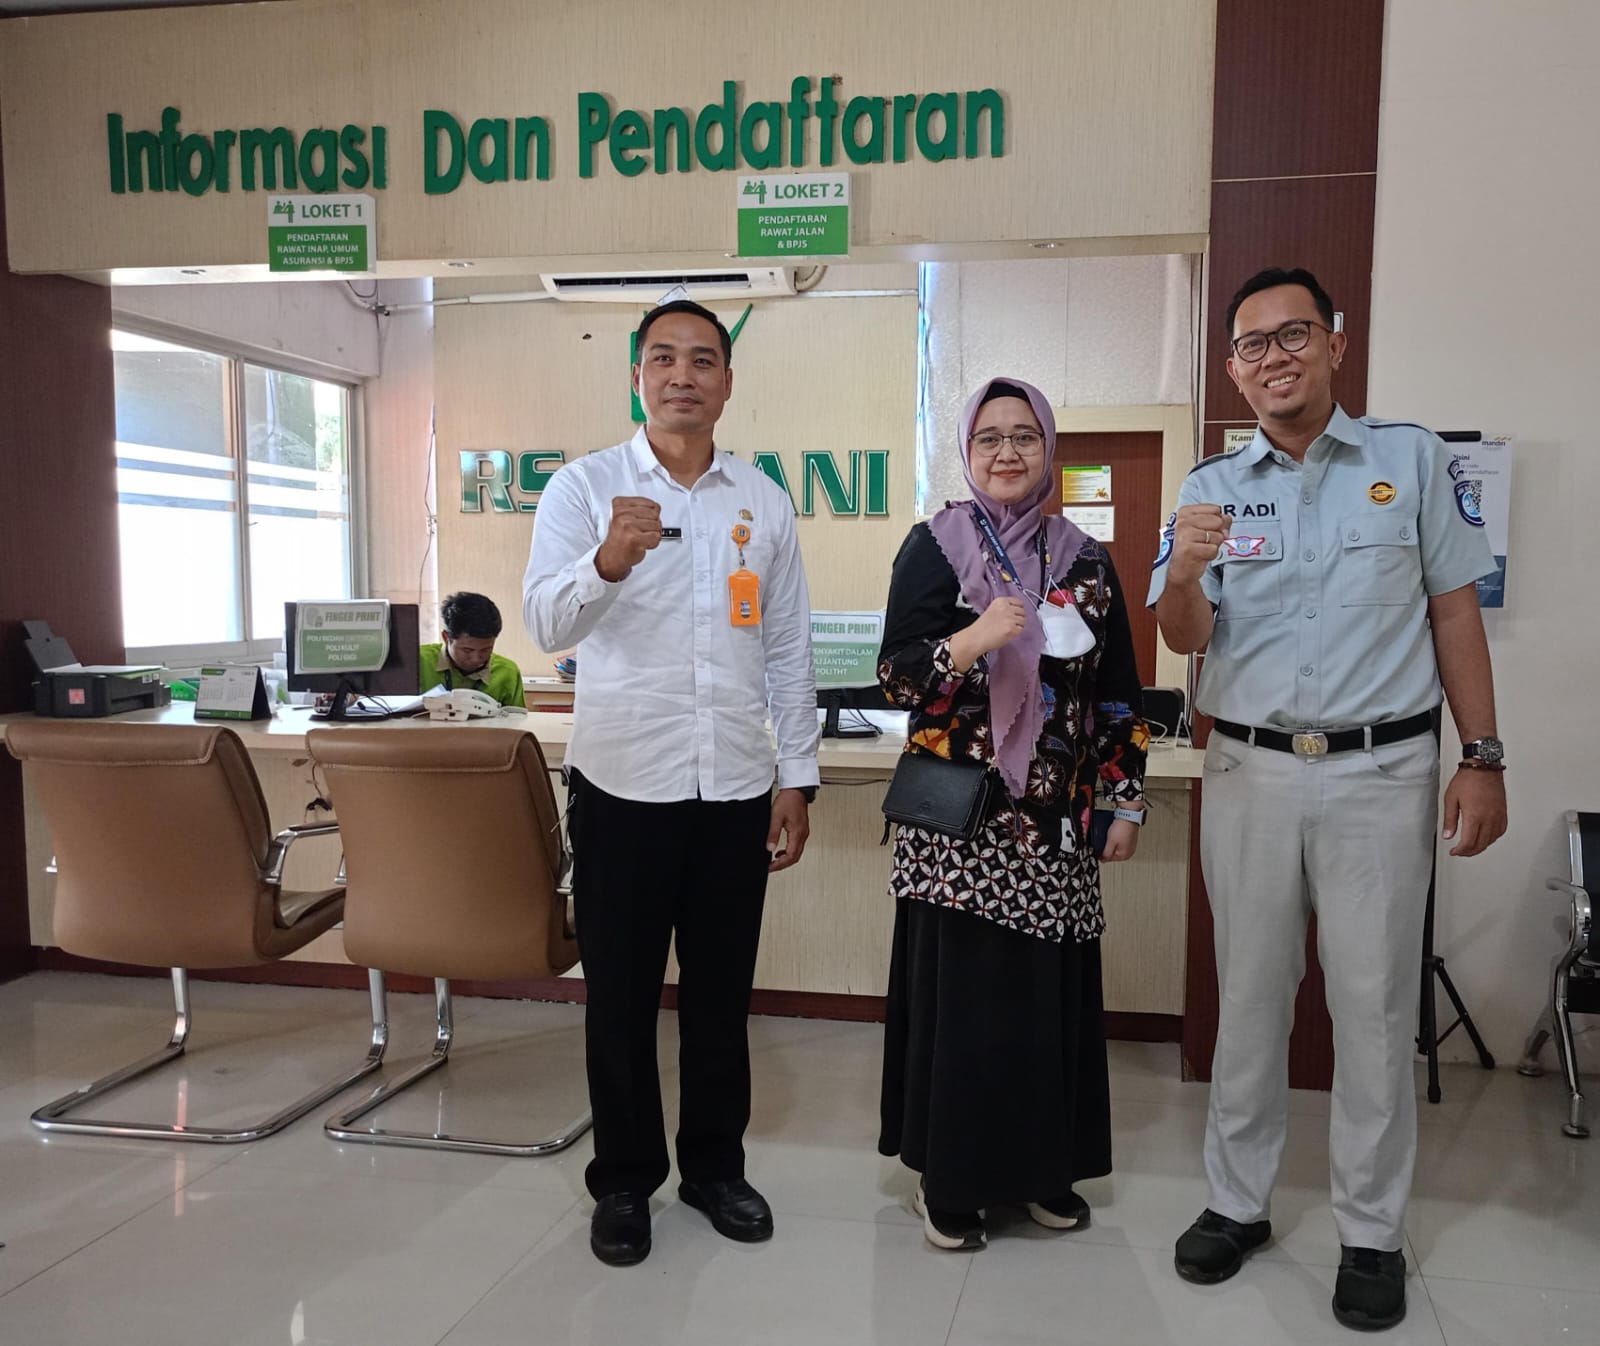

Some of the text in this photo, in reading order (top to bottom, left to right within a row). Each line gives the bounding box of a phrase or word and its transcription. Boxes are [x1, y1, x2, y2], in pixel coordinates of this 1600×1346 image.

[107, 75, 1005, 197] Informasi Dan Pendaftaran
[774, 183, 844, 199] LOKET 2
[302, 204, 362, 218] LOKET 1
[758, 214, 827, 225] PENDAFTARAN
[287, 233, 349, 242] PENDAFTARAN
[760, 227, 825, 237] RAWAT JALAN
[277, 245, 307, 253] RAWAT
[330, 245, 359, 253] UMUM
[777, 240, 808, 249] & BPJS
[282, 256, 354, 265] ASURANSI & BPJS
[460, 451, 564, 516] RS
[1243, 502, 1275, 517] ADI
[355, 611, 381, 622] PRINT
[811, 622, 877, 634] FINGER PRINT
[845, 648, 873, 657] DALAM
[822, 658, 859, 666] JANTUNG
